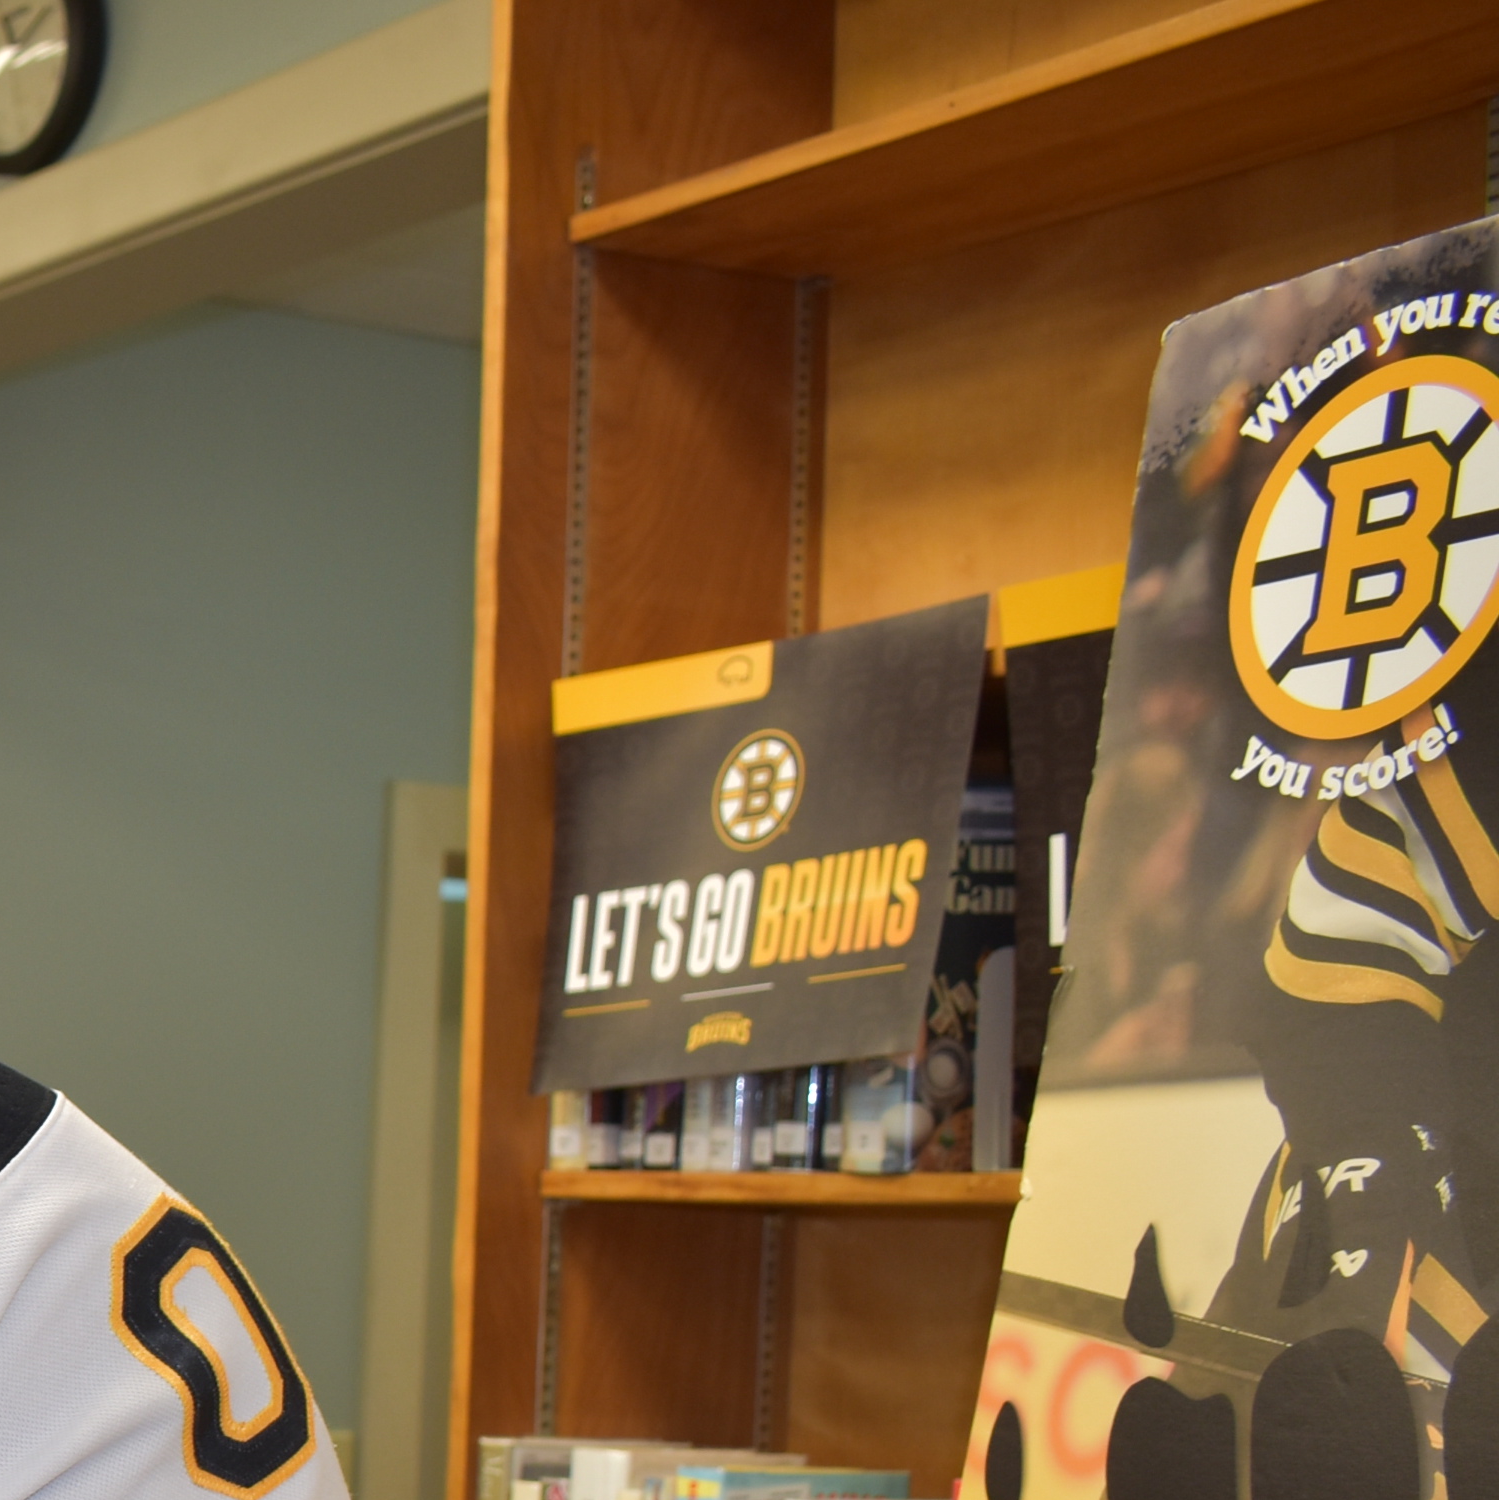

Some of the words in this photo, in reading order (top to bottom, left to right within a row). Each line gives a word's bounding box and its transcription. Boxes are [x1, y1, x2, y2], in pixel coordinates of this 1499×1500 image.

[1240, 325, 1367, 444] When
[1372, 293, 1457, 357] you
[1231, 736, 1311, 799] you
[1318, 703, 1462, 801] score!
[564, 879, 690, 994] LET'S
[686, 868, 755, 978] GO
[750, 838, 928, 968] BRUINS
